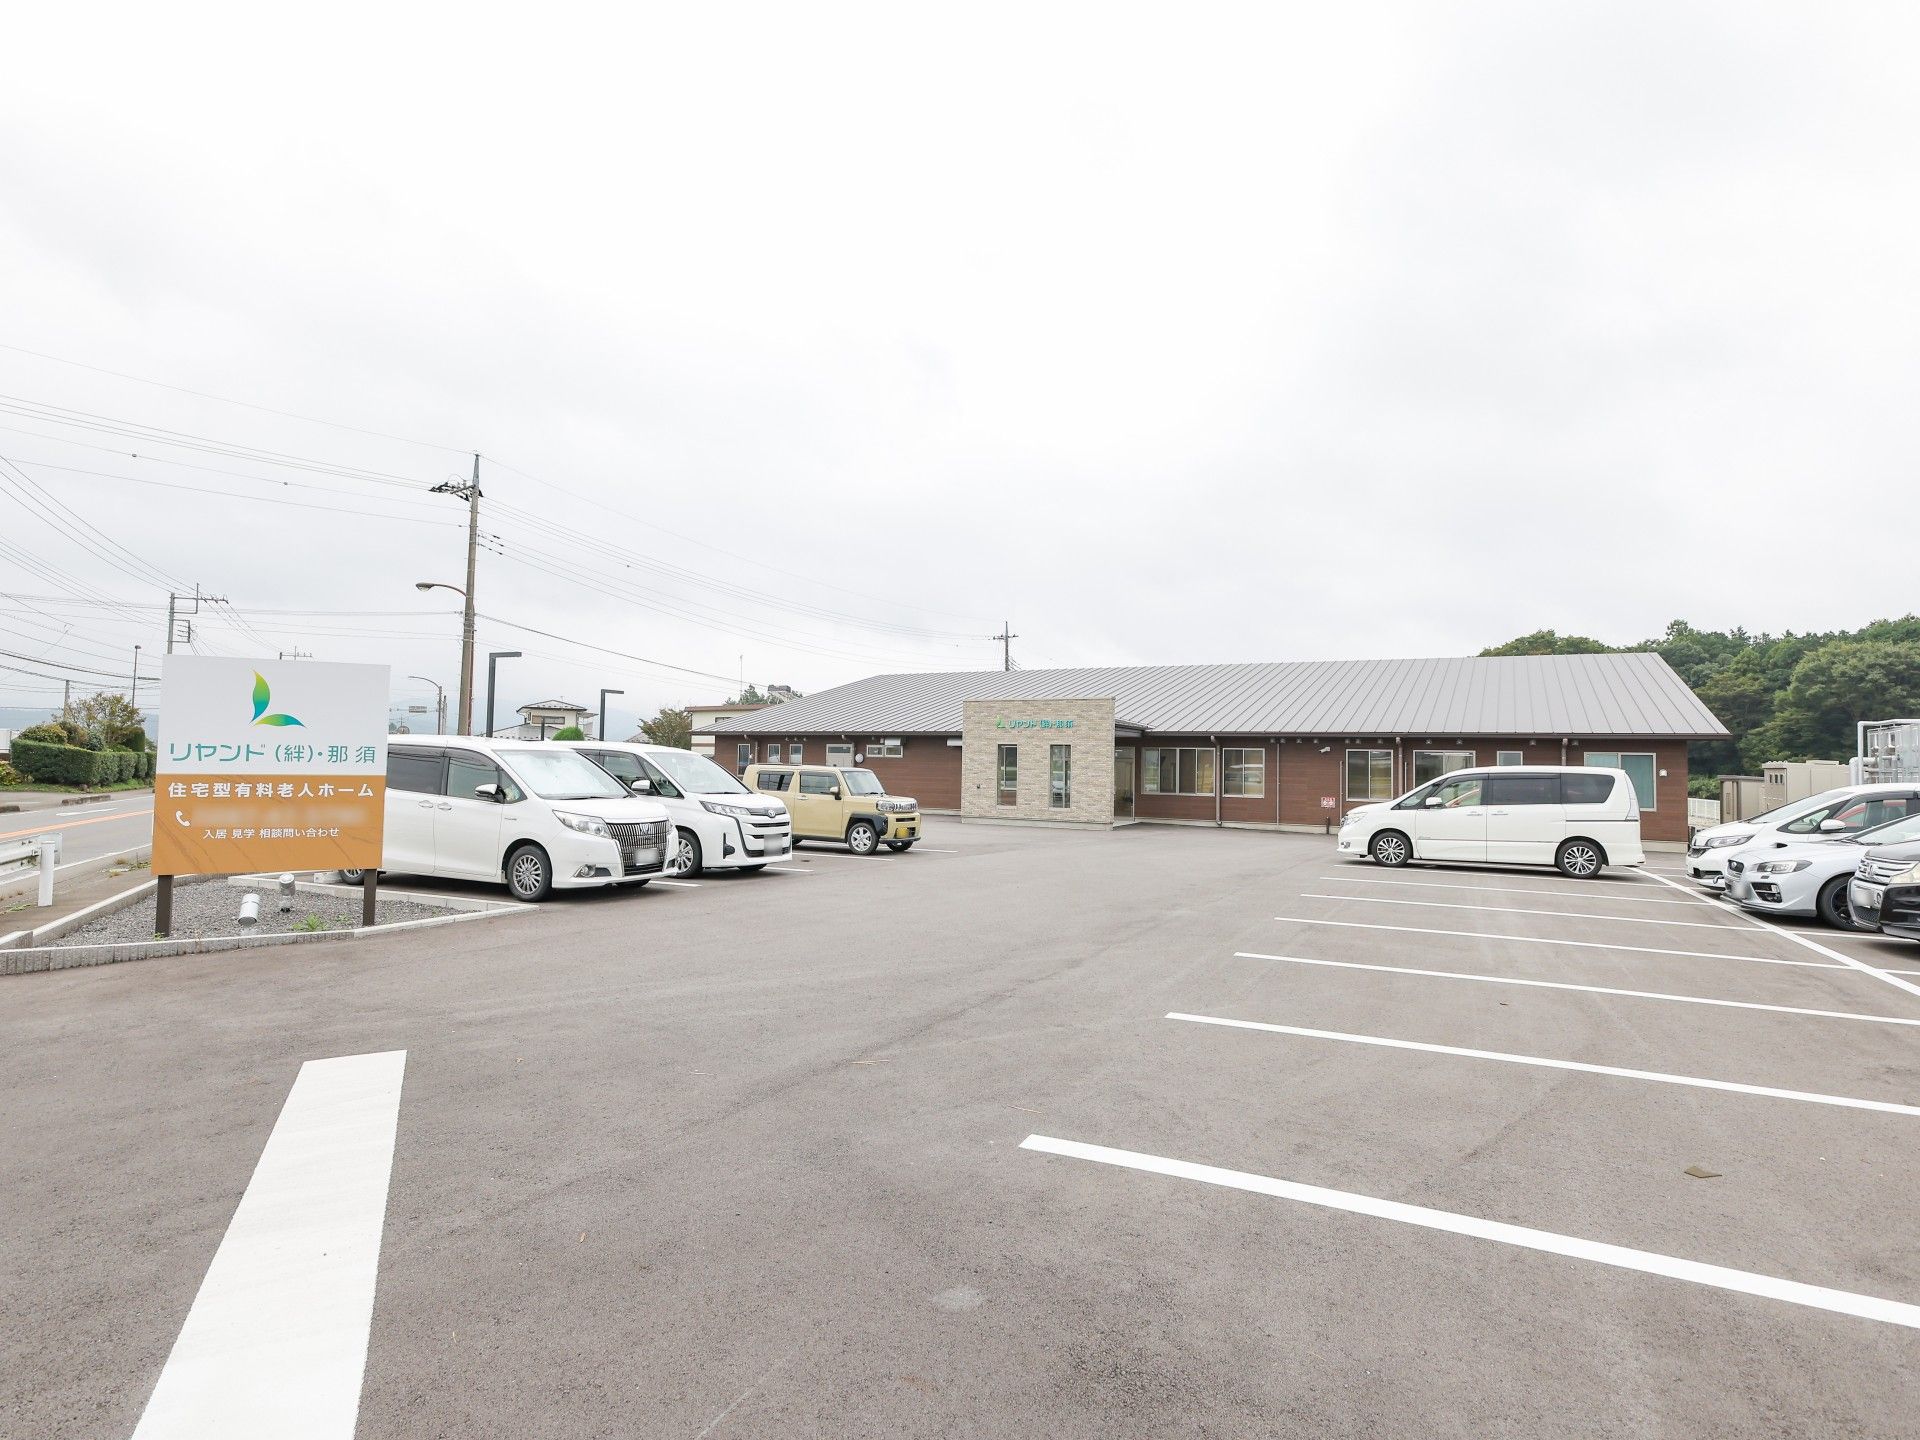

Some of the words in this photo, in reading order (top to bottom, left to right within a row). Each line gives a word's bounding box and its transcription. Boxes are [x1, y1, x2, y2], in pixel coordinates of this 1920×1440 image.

[168, 782, 374, 798] 住宅型有料老人ホーム
[203, 829, 227, 839] 入居
[231, 828, 255, 839] 見学
[259, 827, 340, 839] 相談問い合わせ
